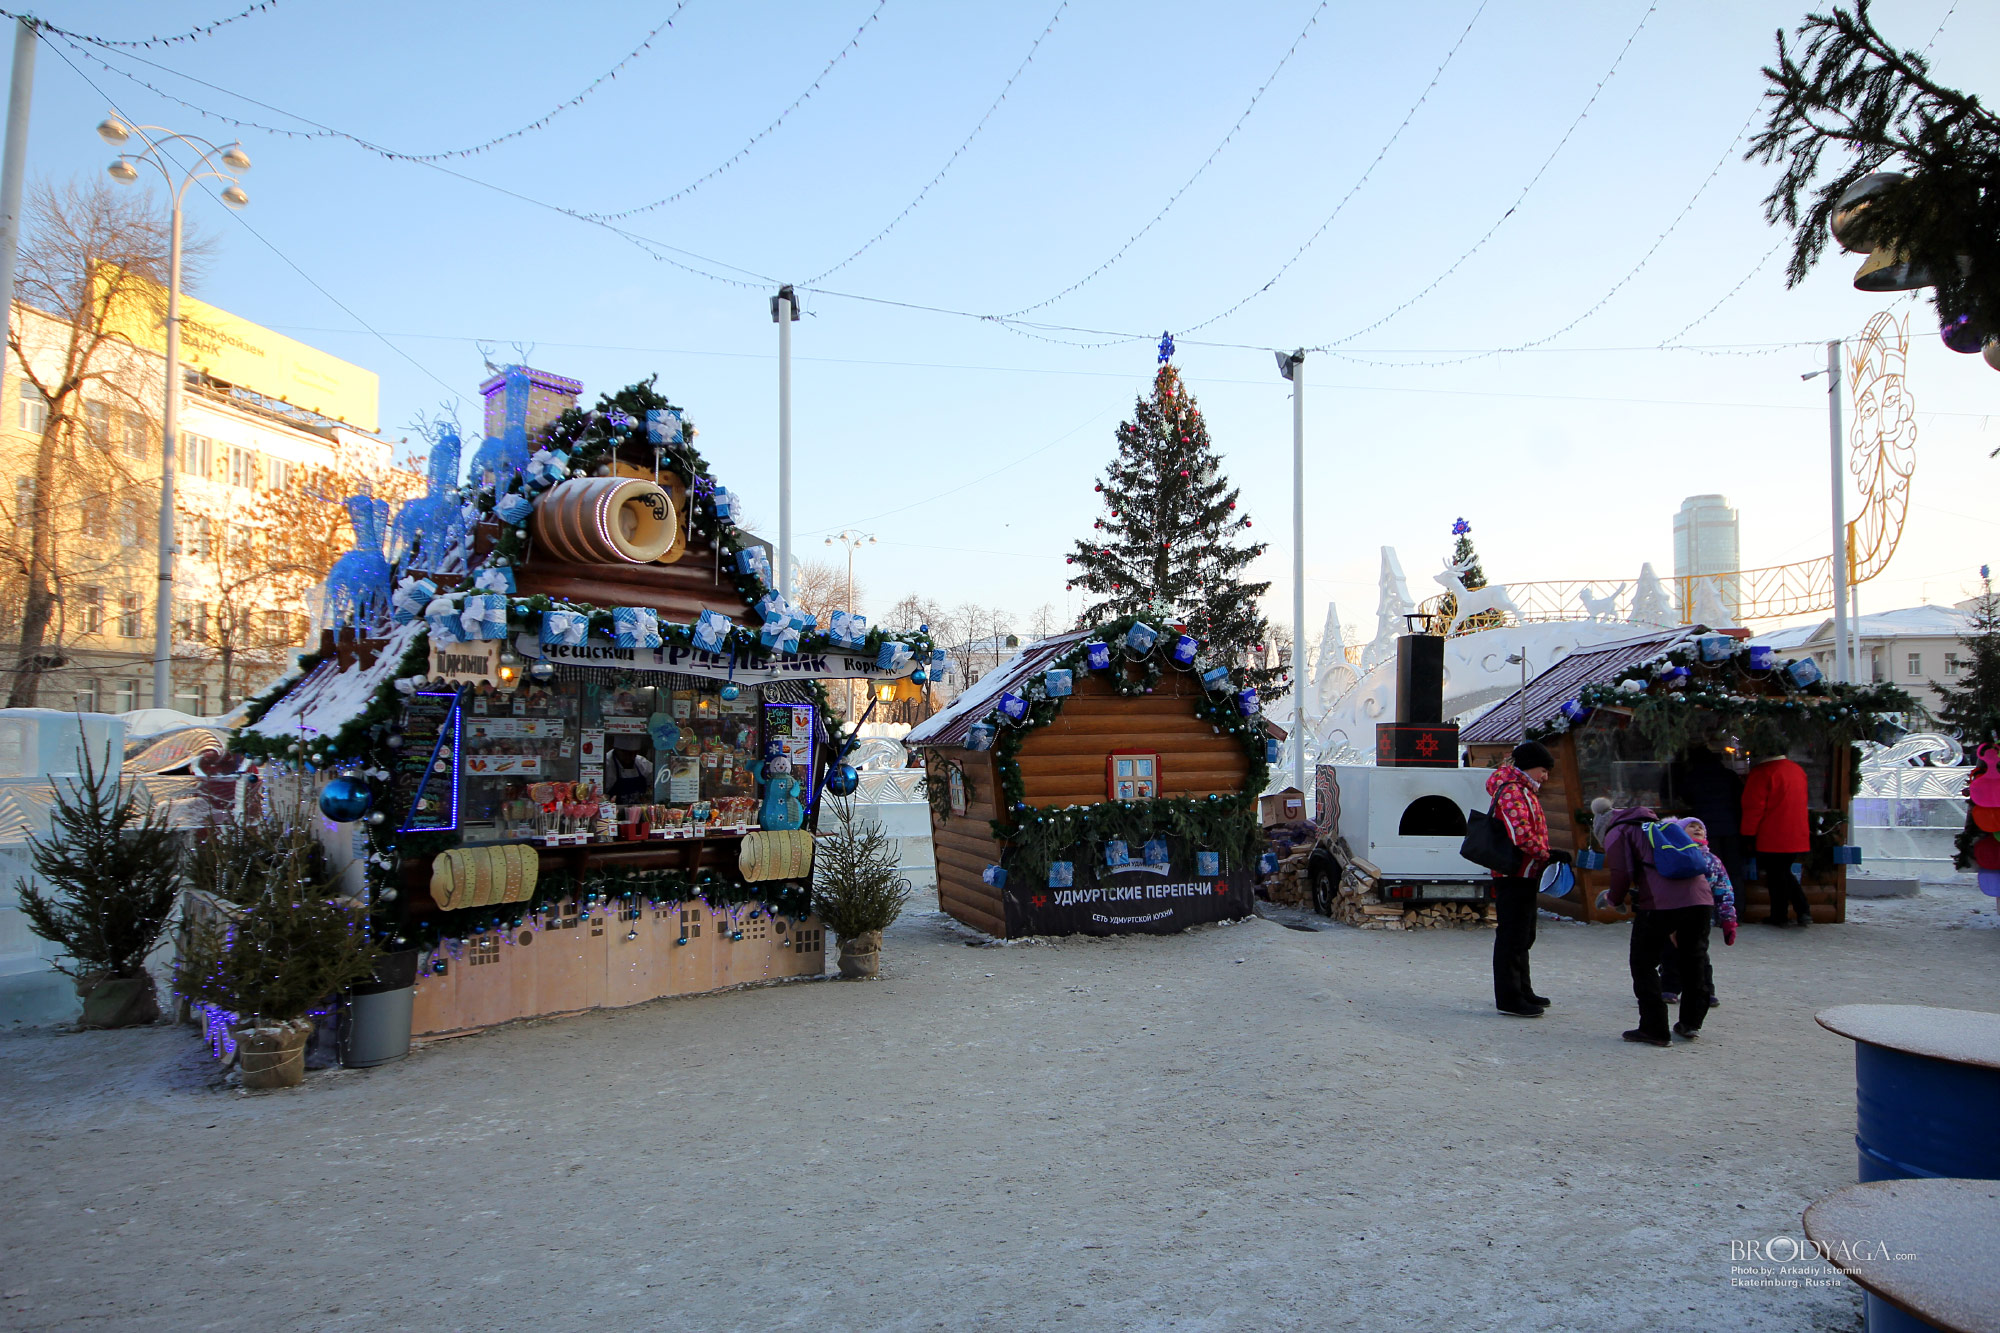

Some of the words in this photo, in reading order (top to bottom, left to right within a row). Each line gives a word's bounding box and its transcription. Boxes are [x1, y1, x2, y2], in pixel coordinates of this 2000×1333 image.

[181, 331, 221, 358] БАНК
[1053, 885, 1142, 907] УДМУРТСКИЕ
[1146, 882, 1212, 900] ПЕРЕПЕЧИ
[1092, 913, 1109, 923] СЕТЬ
[1109, 914, 1152, 925] УДМУРТСКОЙ
[1152, 908, 1174, 921] КУХНИ
